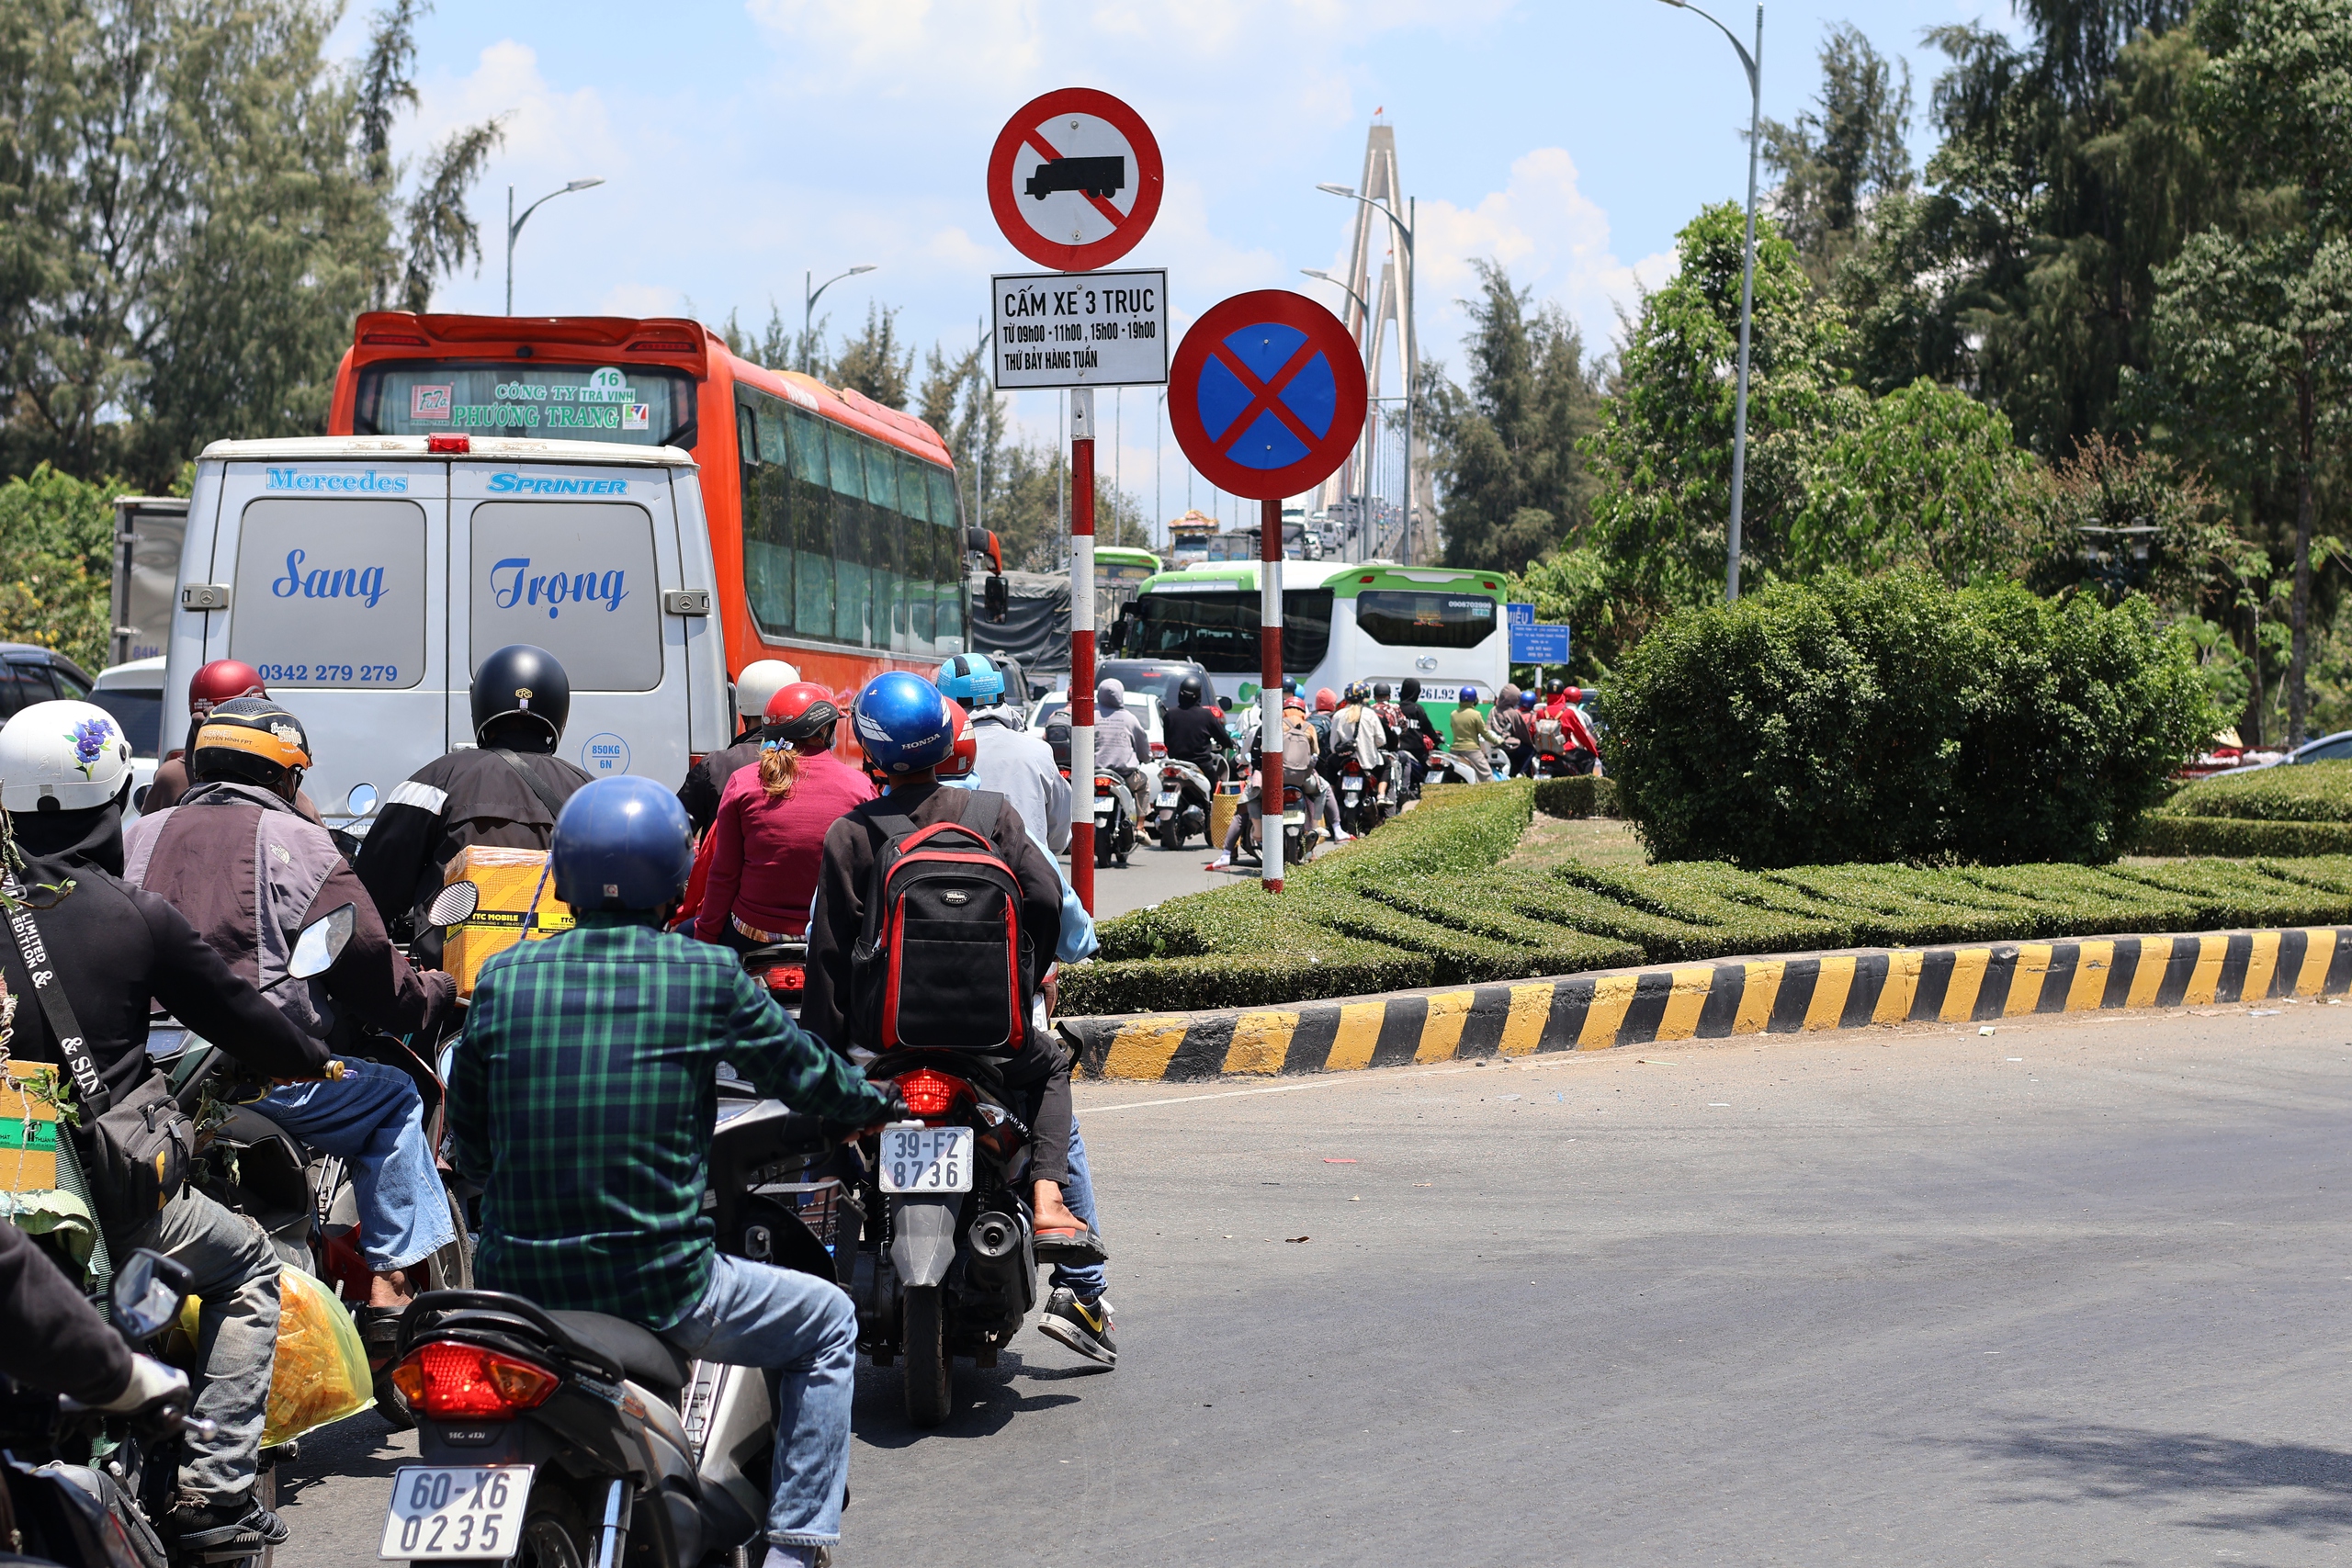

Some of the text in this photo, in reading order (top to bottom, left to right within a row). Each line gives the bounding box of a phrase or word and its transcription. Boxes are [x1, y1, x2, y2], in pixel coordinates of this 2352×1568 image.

[1005, 285, 1155, 319] CẤM XE 3 TRỤC
[1003, 321, 1015, 344] TỪ
[1017, 324, 1046, 343] 09h00
[1054, 323, 1082, 342] 11h00
[1091, 322, 1118, 341] 15h00
[1127, 321, 1156, 339] 19h00
[1004, 344, 1098, 371] THỨ BẢY HÀNG TUẦN
[495, 381, 579, 400] CÔNG TY
[598, 372, 619, 387] 16
[582, 388, 634, 402] TRÀ VINH
[452, 402, 620, 429] PHƯƠNG TRANG
[266, 468, 408, 493] Mercedes
[272, 549, 629, 620] Sang Trọng
[258, 664, 398, 682] 0342 279 279
[592, 744, 620, 755] 850KG
[901, 733, 941, 750] HONDA
[599, 760, 613, 770] 6N
[488, 914, 519, 922] MOBILE
[11, 916, 39, 969] EDITION
[21, 912, 47, 964] LIMITED
[894, 1132, 958, 1158] 39-F2
[893, 1160, 958, 1188] 8736
[410, 1472, 511, 1510] 60-X6
[401, 1514, 503, 1551] 0235
